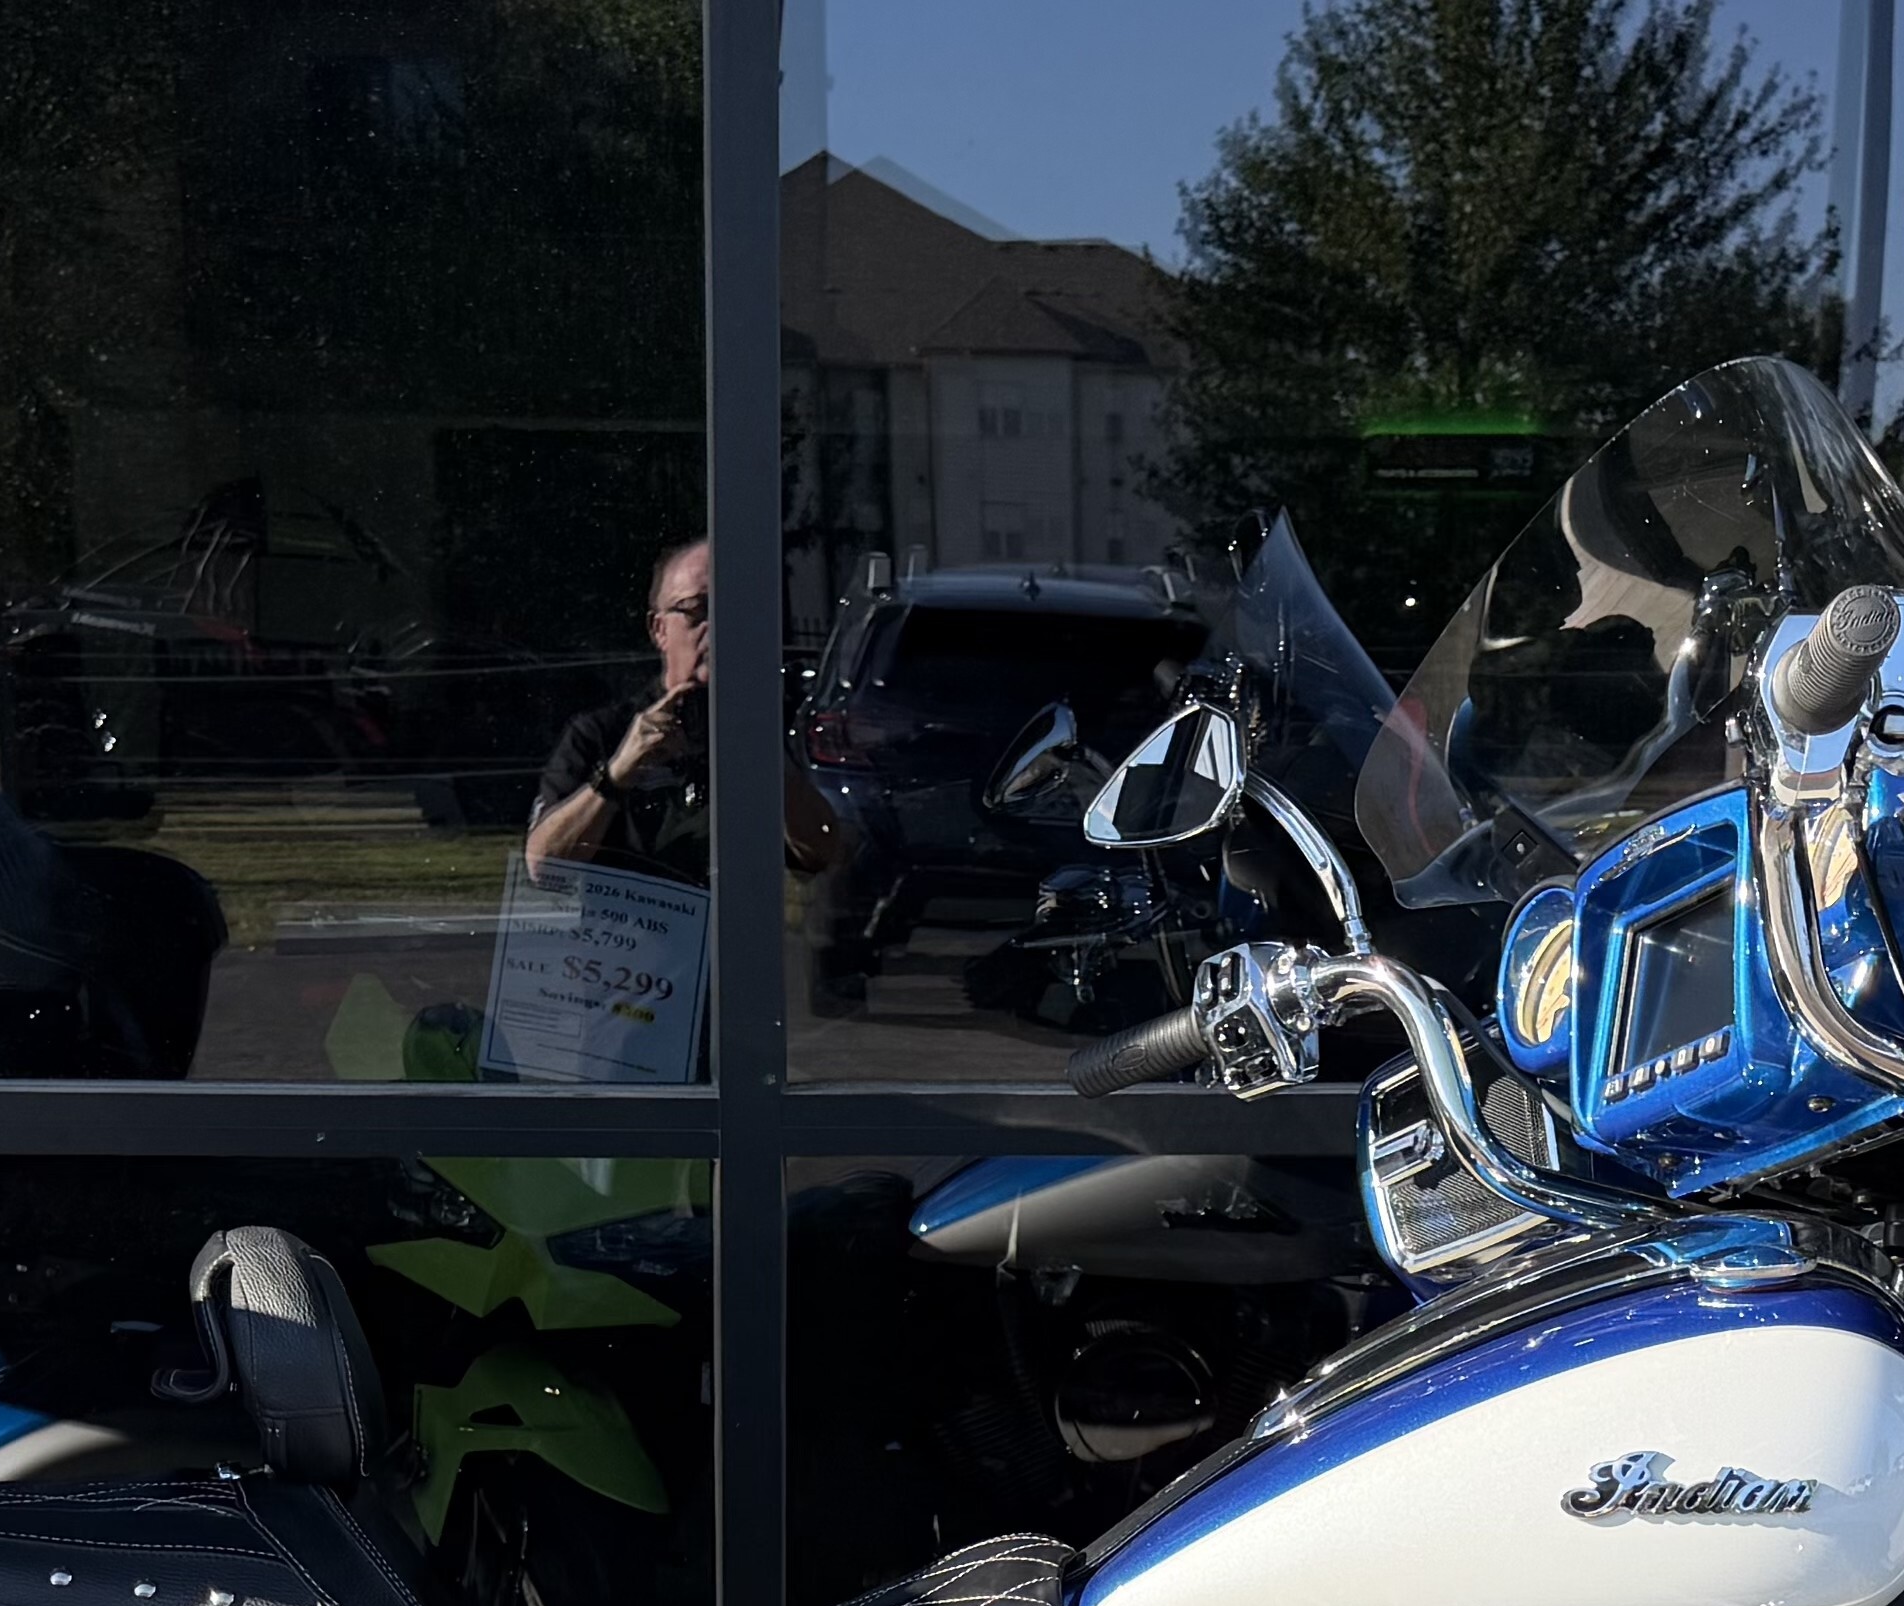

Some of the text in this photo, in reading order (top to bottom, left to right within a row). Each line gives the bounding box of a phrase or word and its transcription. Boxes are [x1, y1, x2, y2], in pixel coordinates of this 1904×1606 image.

[585, 882, 621, 899] 2026
[625, 889, 697, 917] Kawasaki
[570, 926, 637, 951] $5,799
[600, 909, 629, 924] 500
[633, 916, 669, 935] ABS
[561, 954, 674, 1002] $5,299
[1560, 1450, 1818, 1518] Indian
